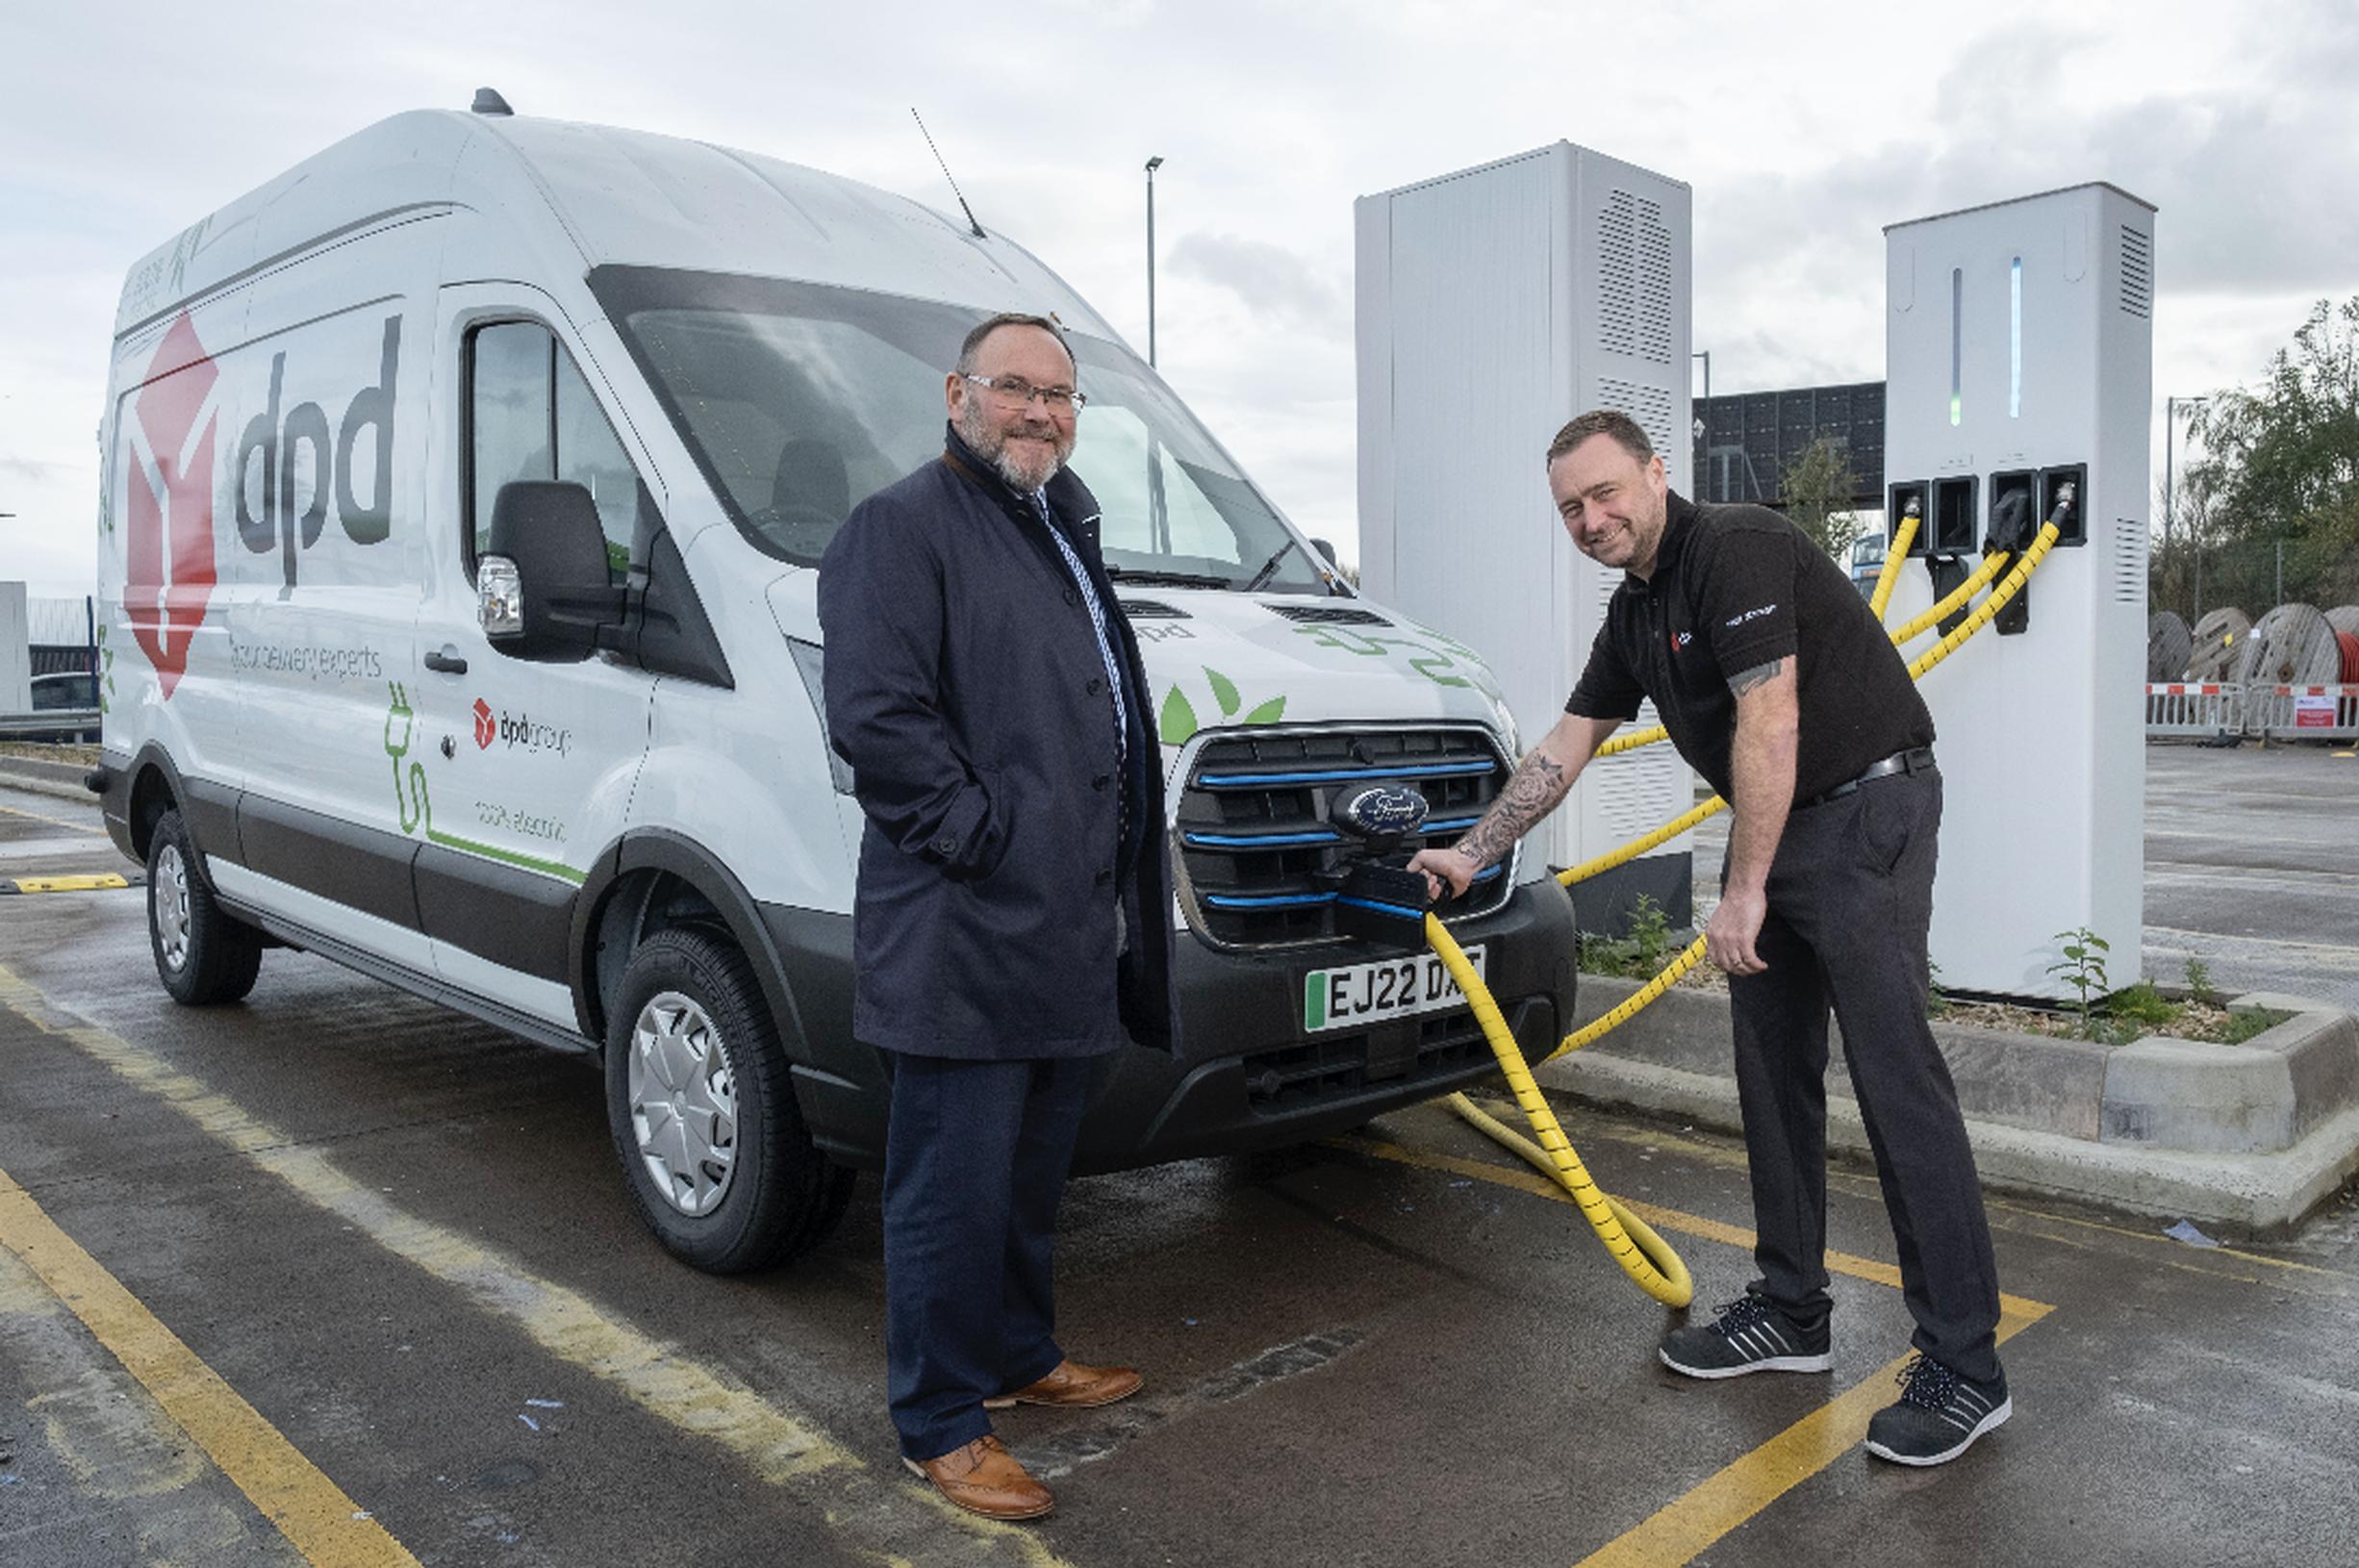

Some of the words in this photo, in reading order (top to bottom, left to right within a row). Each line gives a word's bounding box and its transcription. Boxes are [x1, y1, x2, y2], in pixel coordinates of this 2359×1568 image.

[236, 314, 402, 601] dpd
[1135, 622, 1197, 643] pd
[318, 645, 382, 683] experts
[1368, 796, 1415, 822] Ford
[1330, 963, 1416, 1019] EJ22
